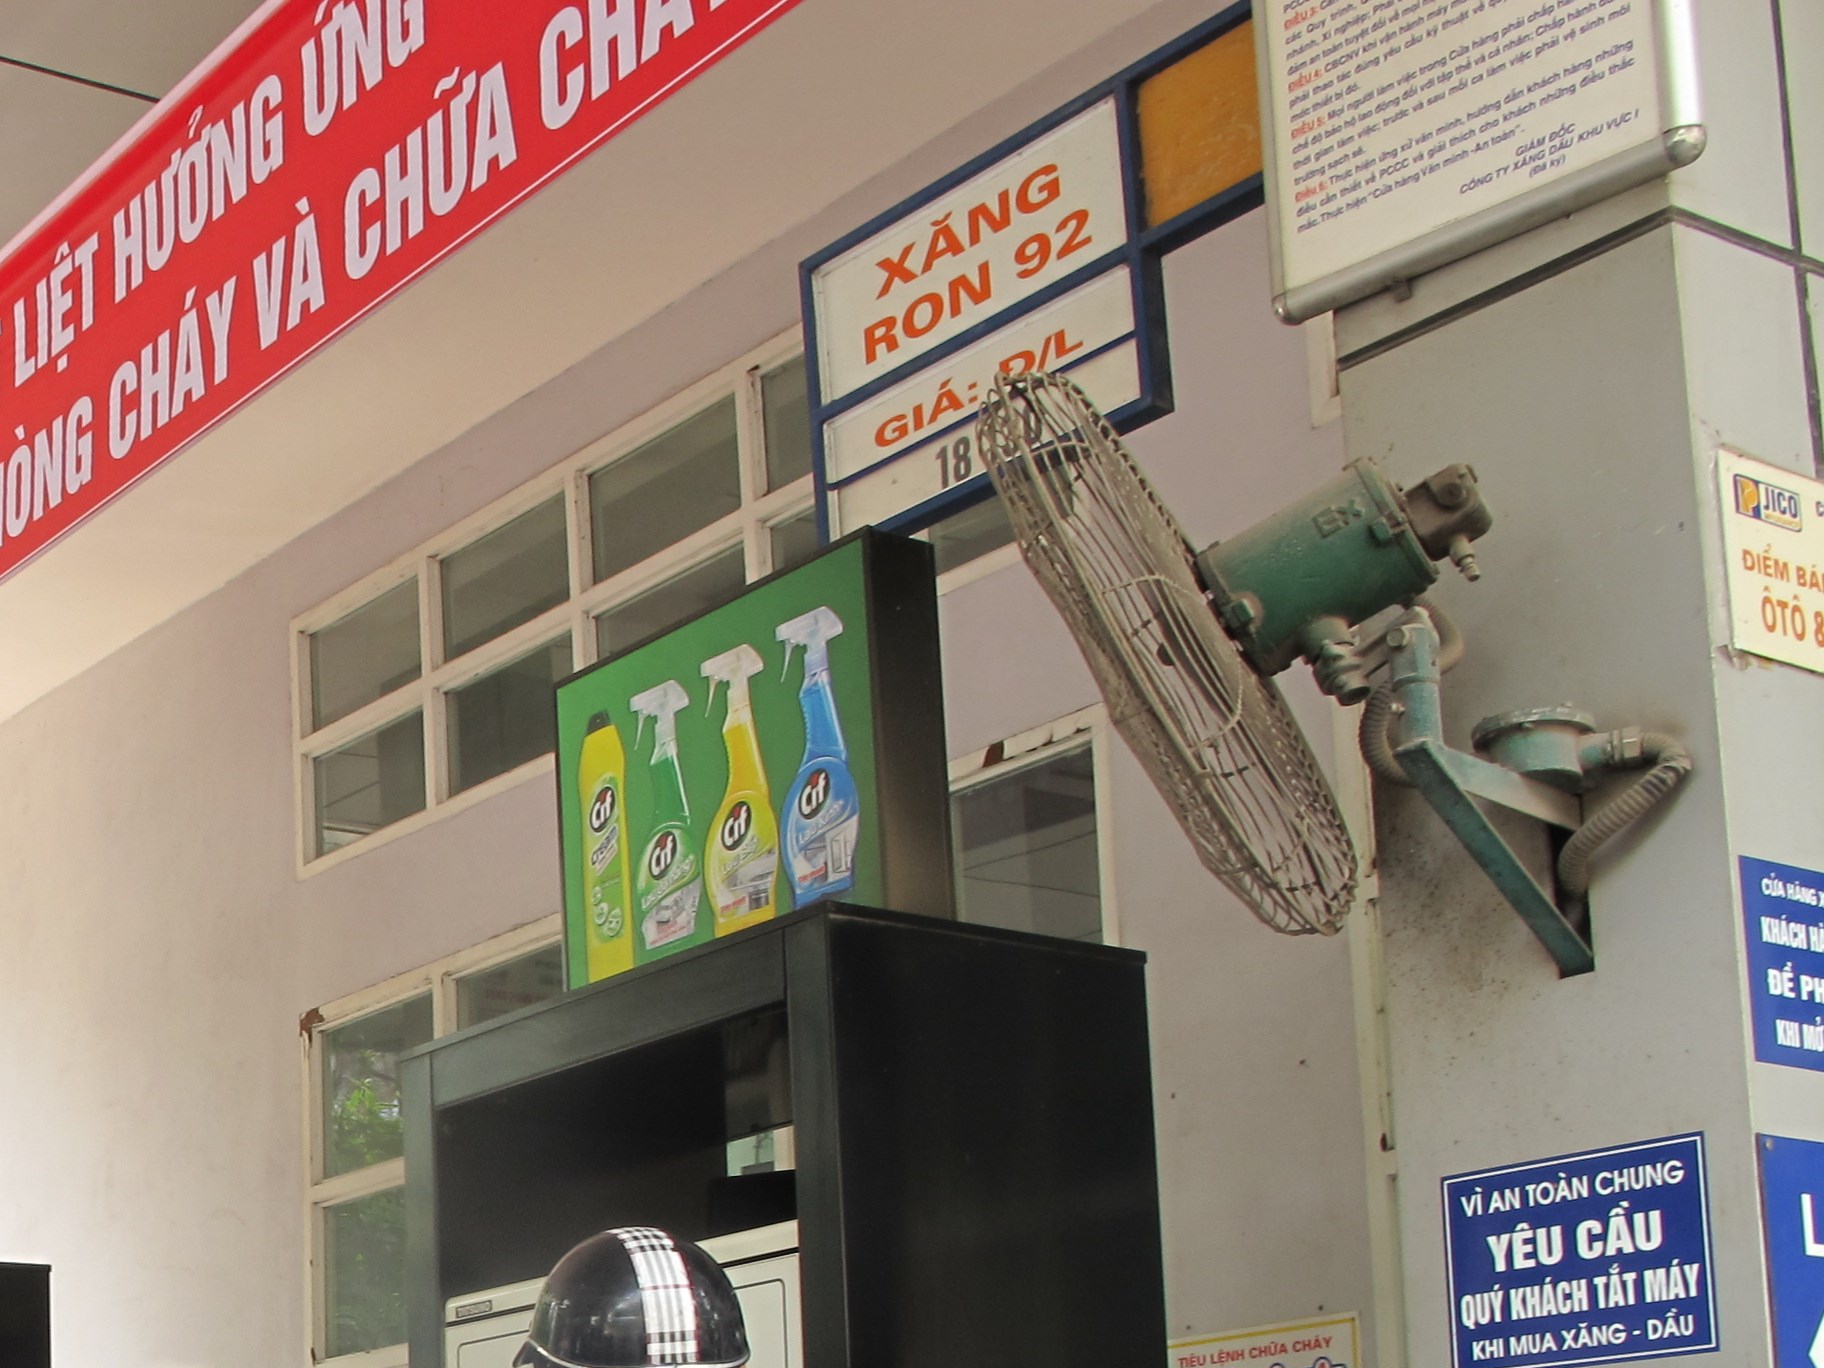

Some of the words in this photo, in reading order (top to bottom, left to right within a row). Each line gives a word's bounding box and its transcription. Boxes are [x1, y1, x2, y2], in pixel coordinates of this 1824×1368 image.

[1495, 165, 1510, 178] TY
[1577, 124, 1603, 143] KHU
[14, 231, 102, 388] LIỆT
[114, 75, 285, 303] HƯỞNG
[301, 0, 426, 136] ỨNG
[876, 162, 1061, 300] XĂNG
[107, 275, 237, 459] CHÁY
[252, 197, 326, 350] VÀ
[344, 61, 518, 280] CHỮA
[863, 260, 990, 365] RON
[1014, 208, 1093, 280] 92
[874, 377, 979, 448] GIÁ:
[1742, 543, 1790, 583] ĐIỂM
[1761, 585, 1806, 641] ÔTÔ
[1761, 872, 1786, 898] CỬA
[1786, 881, 1817, 906] HÀNG
[1760, 915, 1807, 949] KHÁCH
[1767, 962, 1796, 998] ĐỂ
[1776, 1019, 1800, 1048] KHI
[1460, 1187, 1483, 1217] VÌ
[1488, 1188, 1520, 1214] AN
[1526, 1172, 1588, 1208] TOÀN
[1595, 1160, 1685, 1196] CHUNG
[1486, 1222, 1564, 1272] YÊU
[1576, 1201, 1663, 1260] CẦU
[1460, 1284, 1504, 1330] QUÝ
[1510, 1277, 1589, 1320] KHÁCH
[1593, 1263, 1636, 1310] TẮT
[1644, 1259, 1700, 1303] MÁY
[1472, 1340, 1504, 1361] KHI
[1510, 1332, 1557, 1356] MUA
[1561, 1322, 1626, 1350] XĂNG
[1646, 1308, 1694, 1340] DẦU
